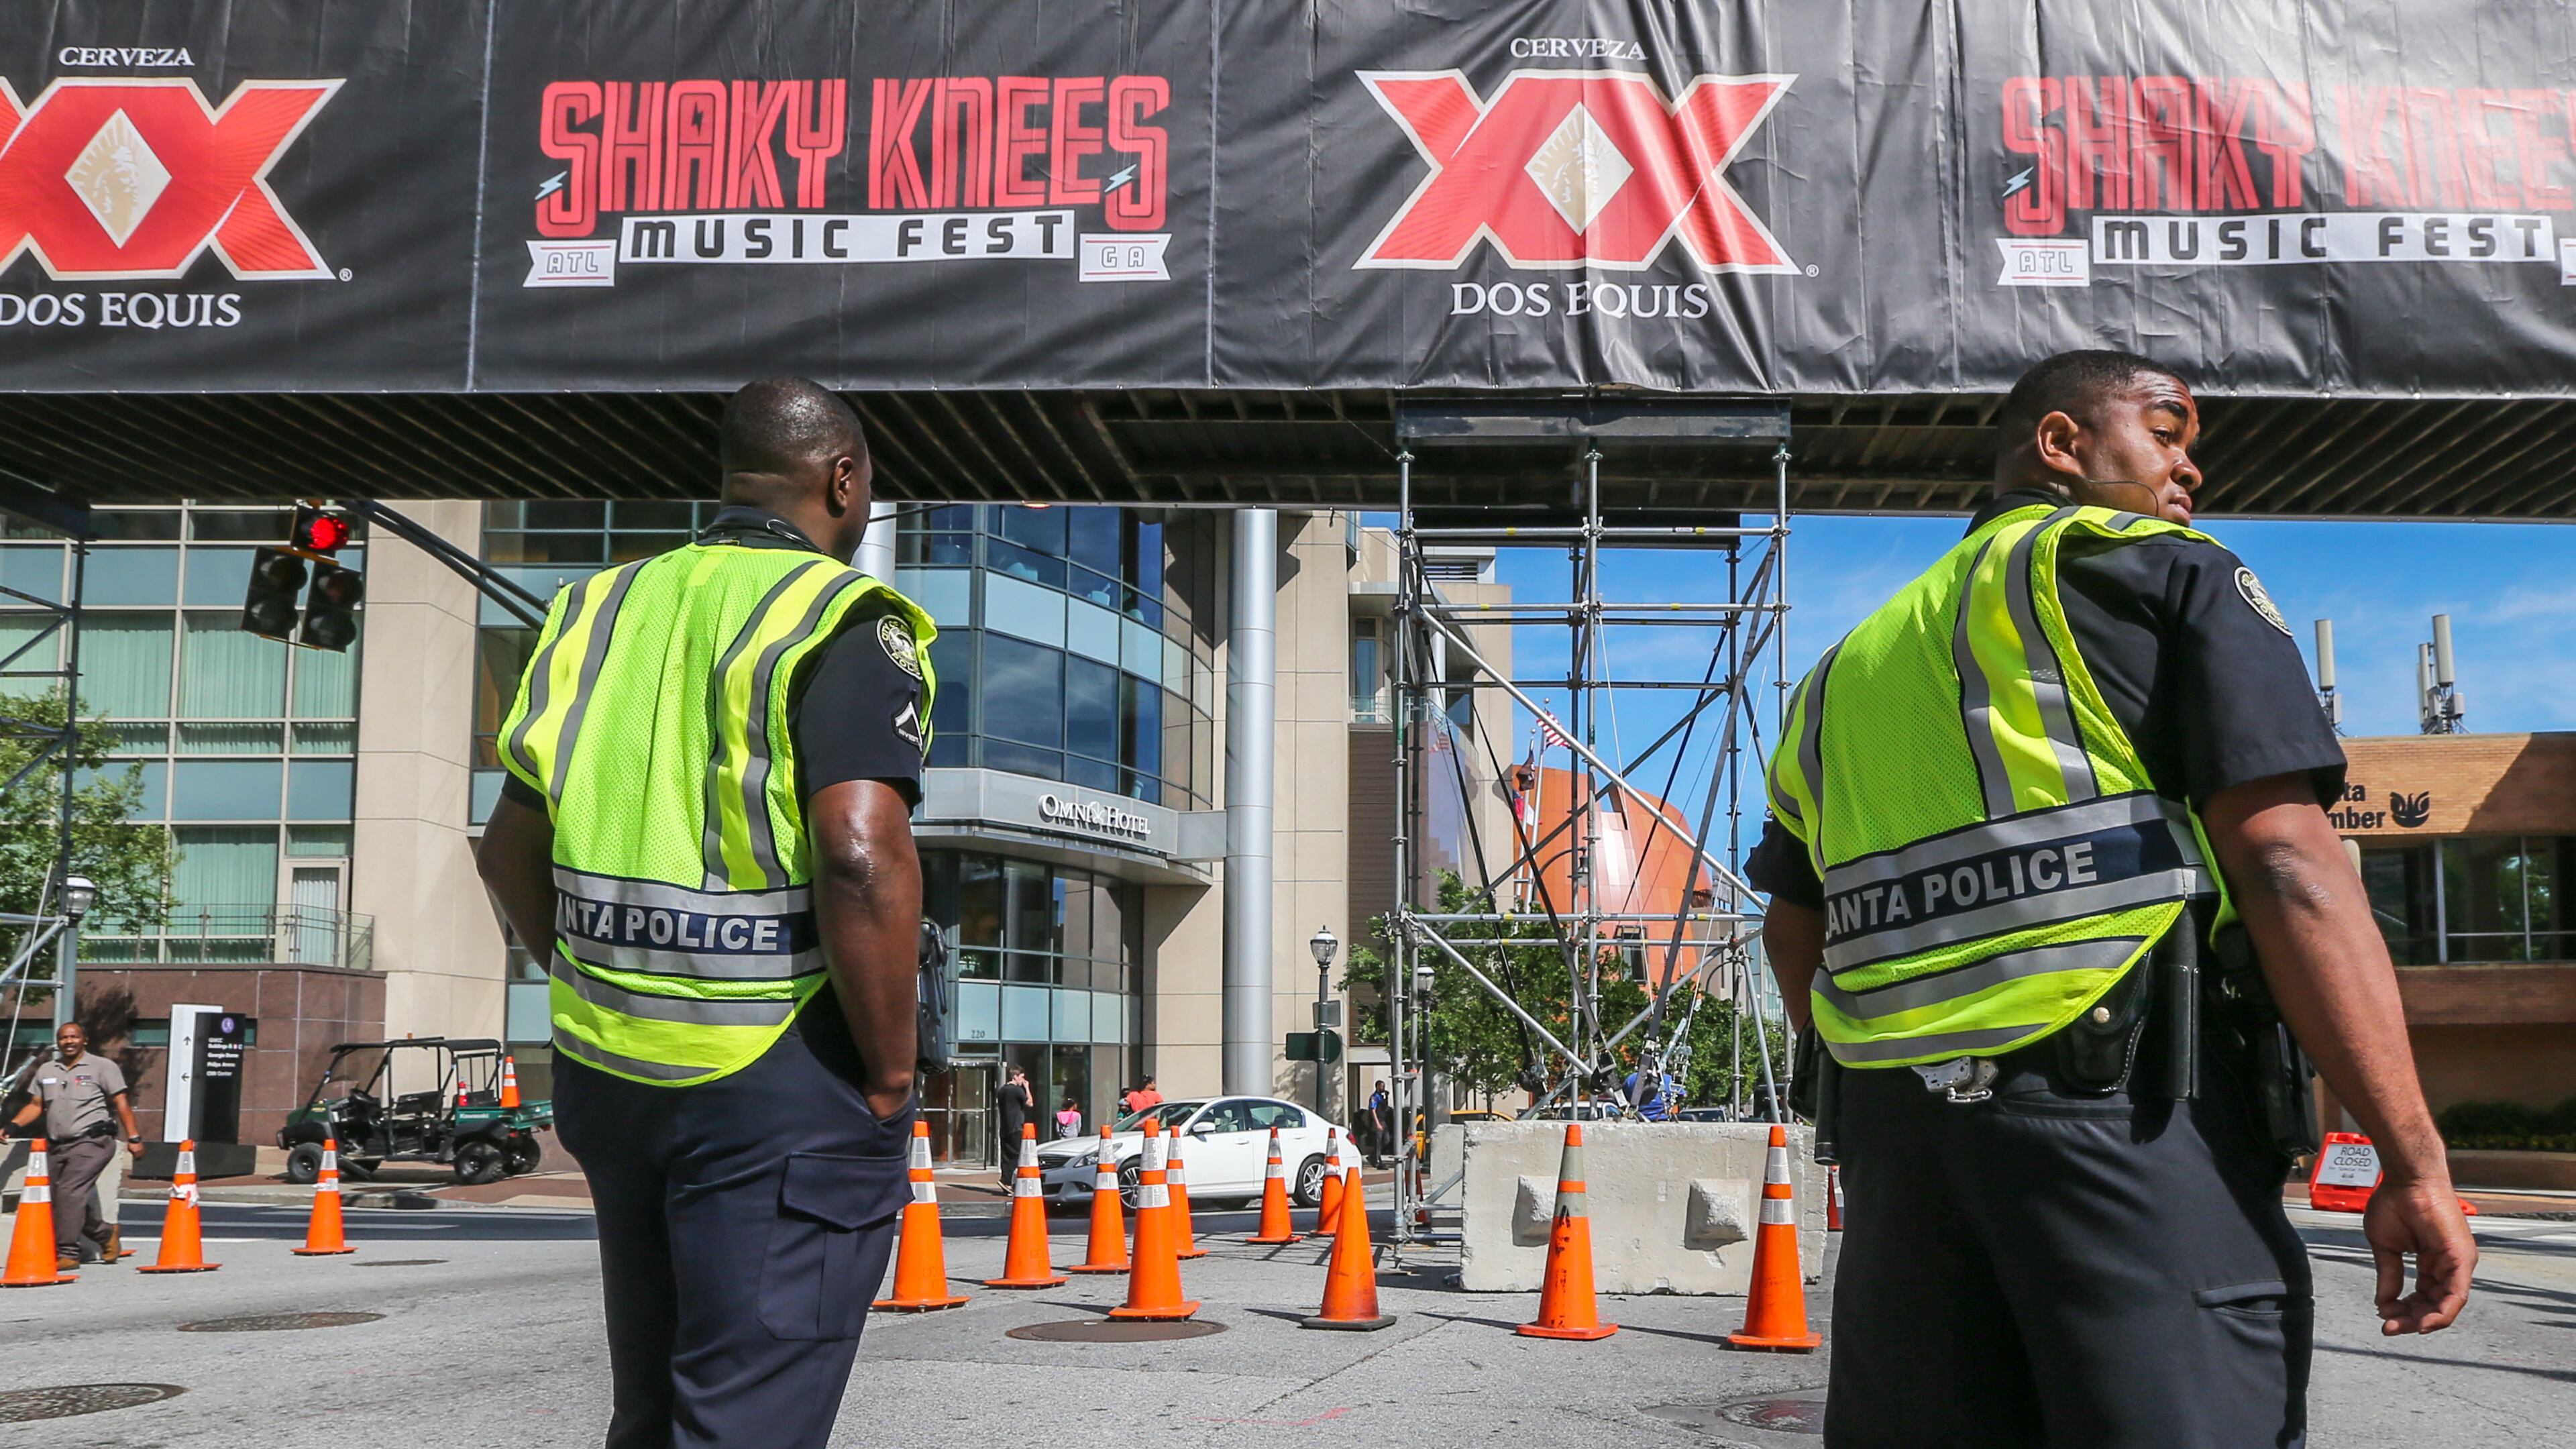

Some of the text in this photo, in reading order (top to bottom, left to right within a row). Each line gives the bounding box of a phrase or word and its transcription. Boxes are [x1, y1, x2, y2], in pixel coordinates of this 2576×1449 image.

[58, 46, 195, 66] CERVEZA
[1509, 38, 1648, 61] CERVEZA
[536, 76, 1171, 237] SHAKY KNEES
[1352, 68, 1803, 274] XX
[2002, 75, 2576, 235] SHAKY KNEE
[631, 215, 1064, 259] MUSIC FEST
[2104, 217, 2541, 260] MUSIC FEST
[546, 252, 599, 274] ATL
[1101, 246, 1147, 268] GA
[2019, 250, 2074, 274] ATL
[0, 292, 241, 329] DOS EQUIS
[1450, 280, 1710, 320] DOS EQUIS
[1826, 842, 2097, 941] ANTA POLICE
[625, 908, 780, 951] POLICE
[971, 1030, 985, 1038] 220
[2334, 1157, 2371, 1167] CLOSED
[2341, 1146, 2371, 1157] ROAD
